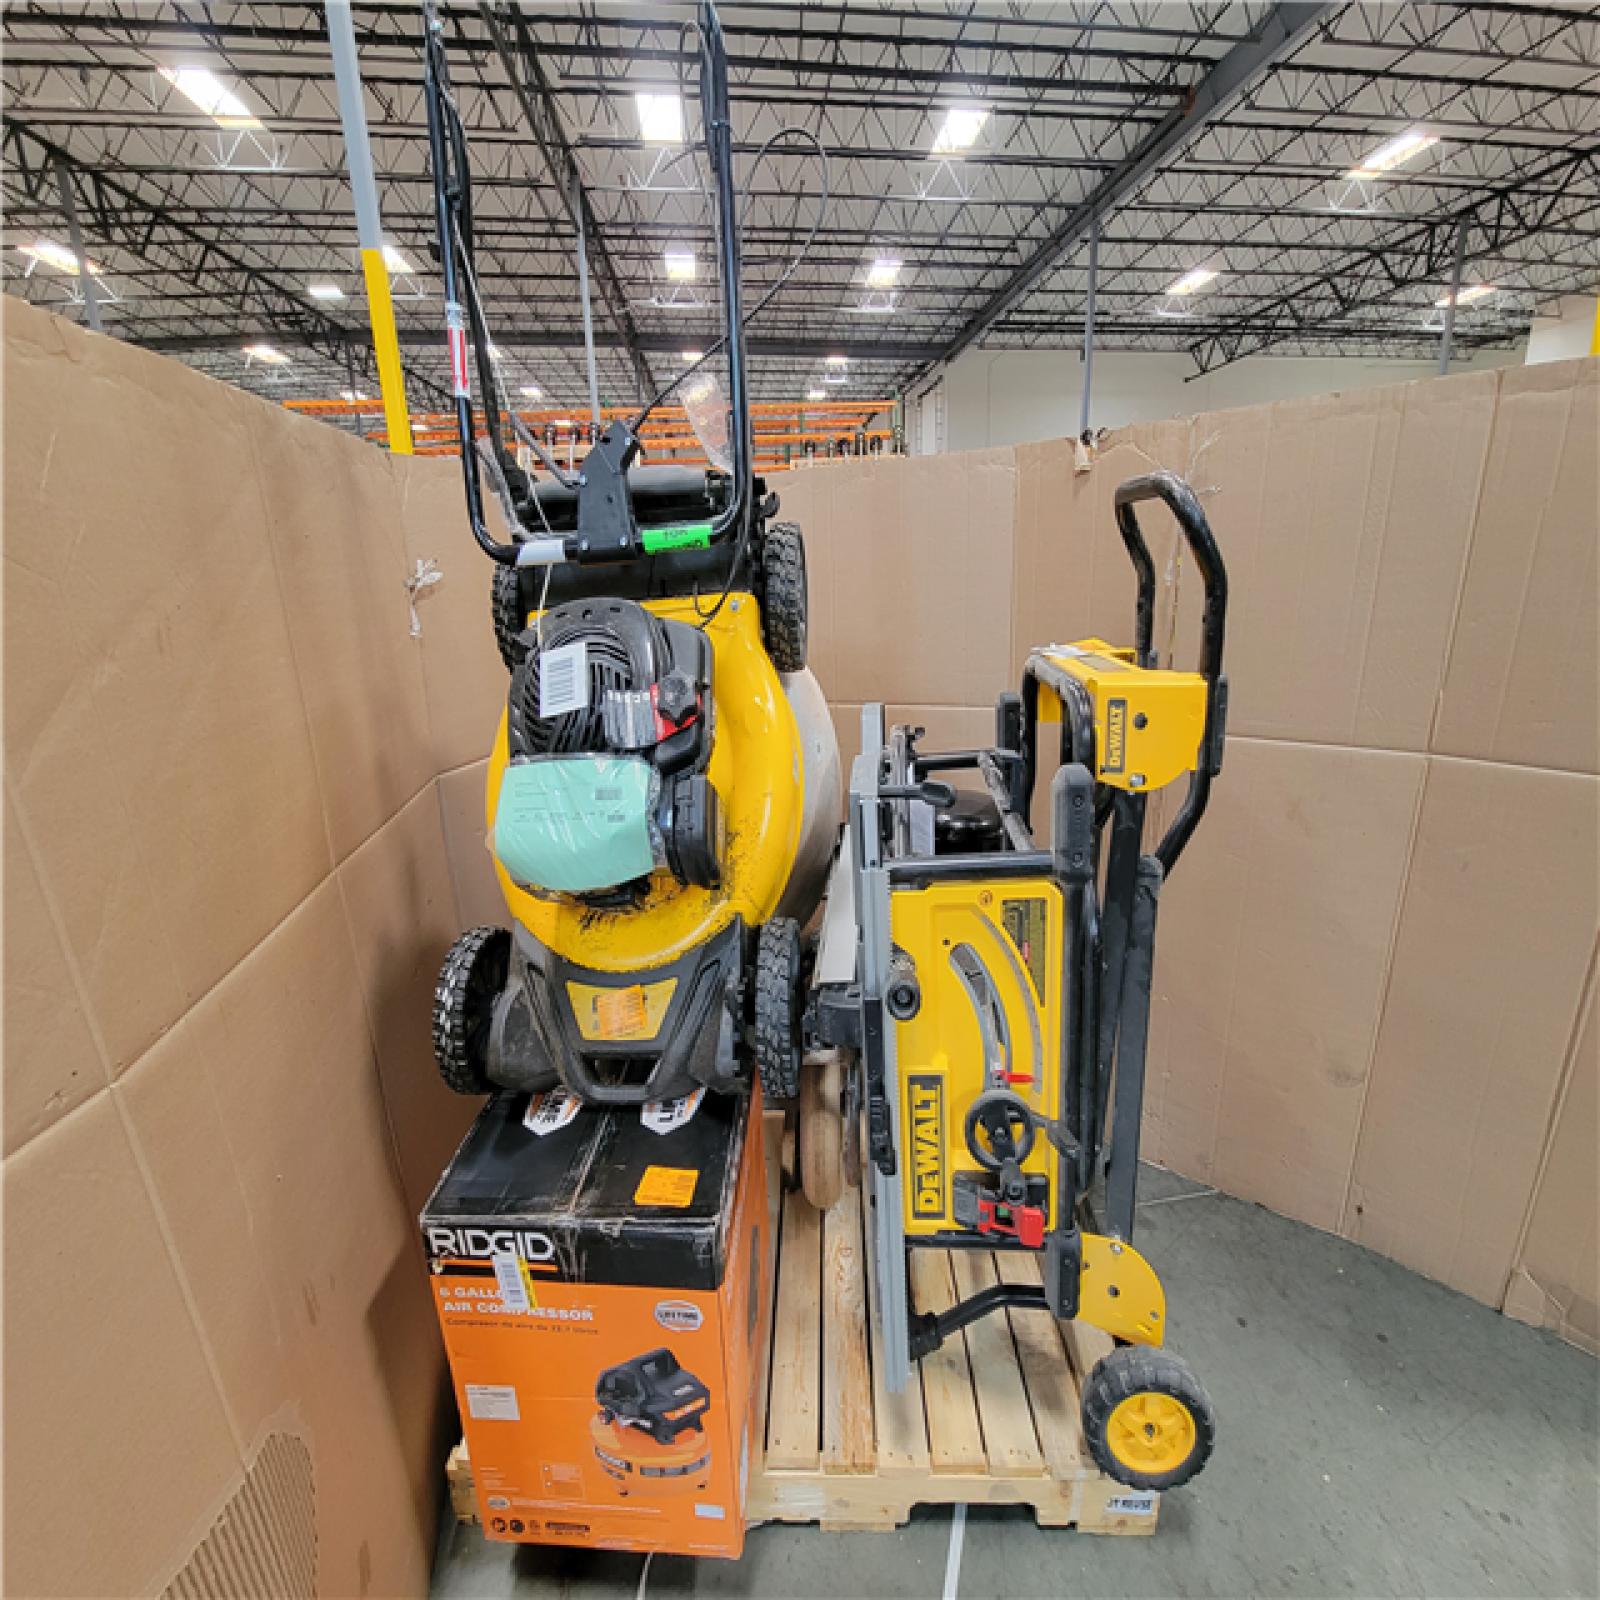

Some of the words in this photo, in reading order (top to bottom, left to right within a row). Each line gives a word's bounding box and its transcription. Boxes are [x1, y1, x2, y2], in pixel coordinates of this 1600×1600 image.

[1108, 705, 1124, 768] DEWALT
[912, 1084, 941, 1212] DEWALT
[429, 1229, 556, 1261] RIDGID
[454, 1287, 504, 1299] GALL
[444, 1302, 472, 1312] AIR
[477, 1302, 594, 1321] CORESSOR
